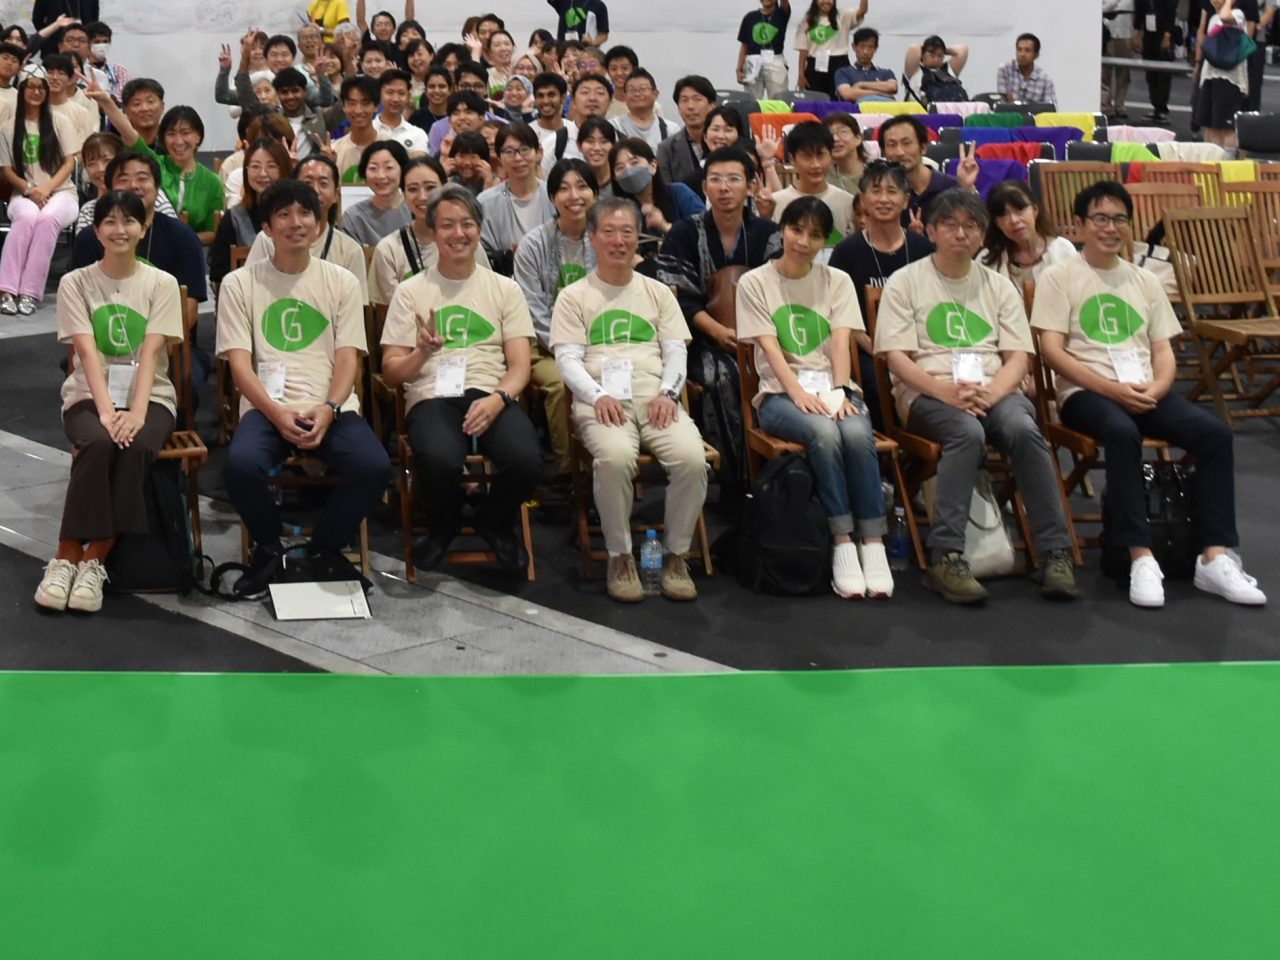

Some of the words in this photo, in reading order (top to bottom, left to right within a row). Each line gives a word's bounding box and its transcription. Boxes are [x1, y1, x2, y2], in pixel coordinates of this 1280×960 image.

[108, 313, 128, 347] G
[281, 307, 302, 342] G
[446, 313, 467, 341] G
[611, 318, 630, 344] G
[789, 313, 807, 346] G
[946, 311, 966, 341] G
[1099, 302, 1119, 336] G
